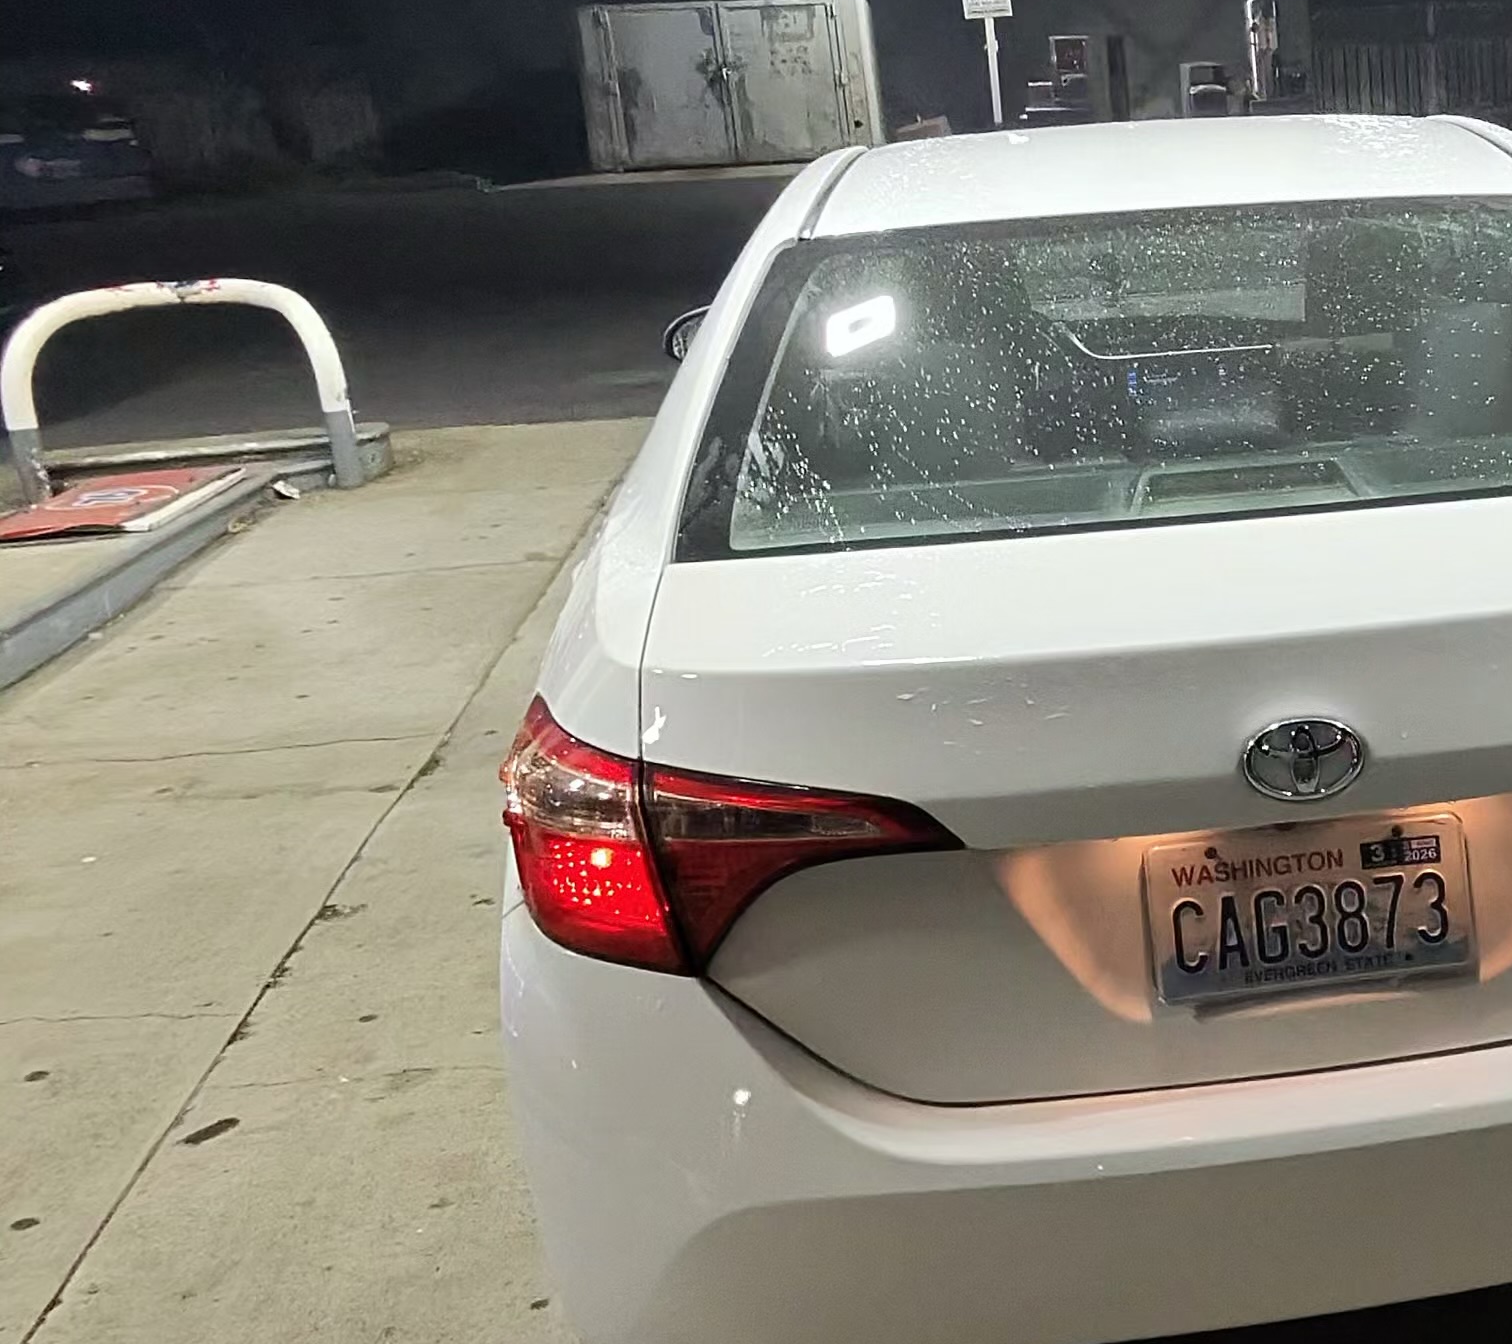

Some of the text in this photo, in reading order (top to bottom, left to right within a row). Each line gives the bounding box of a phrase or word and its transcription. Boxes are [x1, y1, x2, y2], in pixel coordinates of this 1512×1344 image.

[1172, 848, 1344, 887] WASHINGTON
[1404, 848, 1437, 862] 2026
[1172, 871, 1449, 974] CAG3873
[1244, 960, 1338, 985] EVERGREEN
